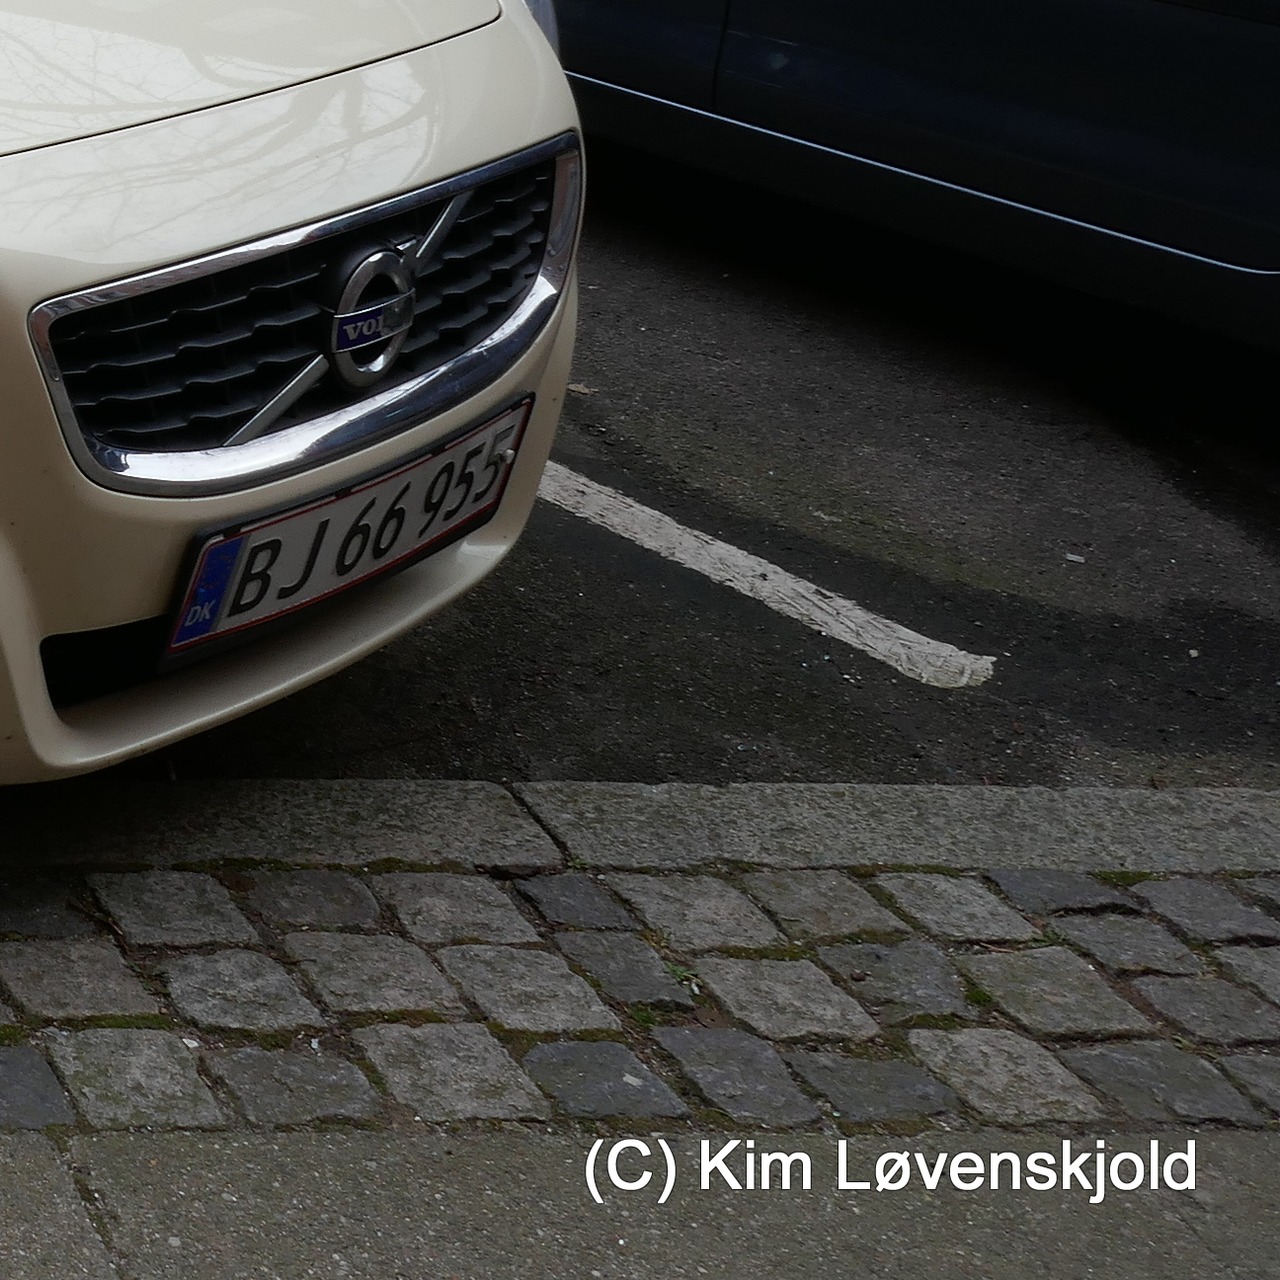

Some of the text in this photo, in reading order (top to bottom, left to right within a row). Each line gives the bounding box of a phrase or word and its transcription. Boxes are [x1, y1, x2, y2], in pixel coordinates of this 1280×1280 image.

[227, 424, 516, 618] BJ 66 955
[184, 599, 217, 627] DK
